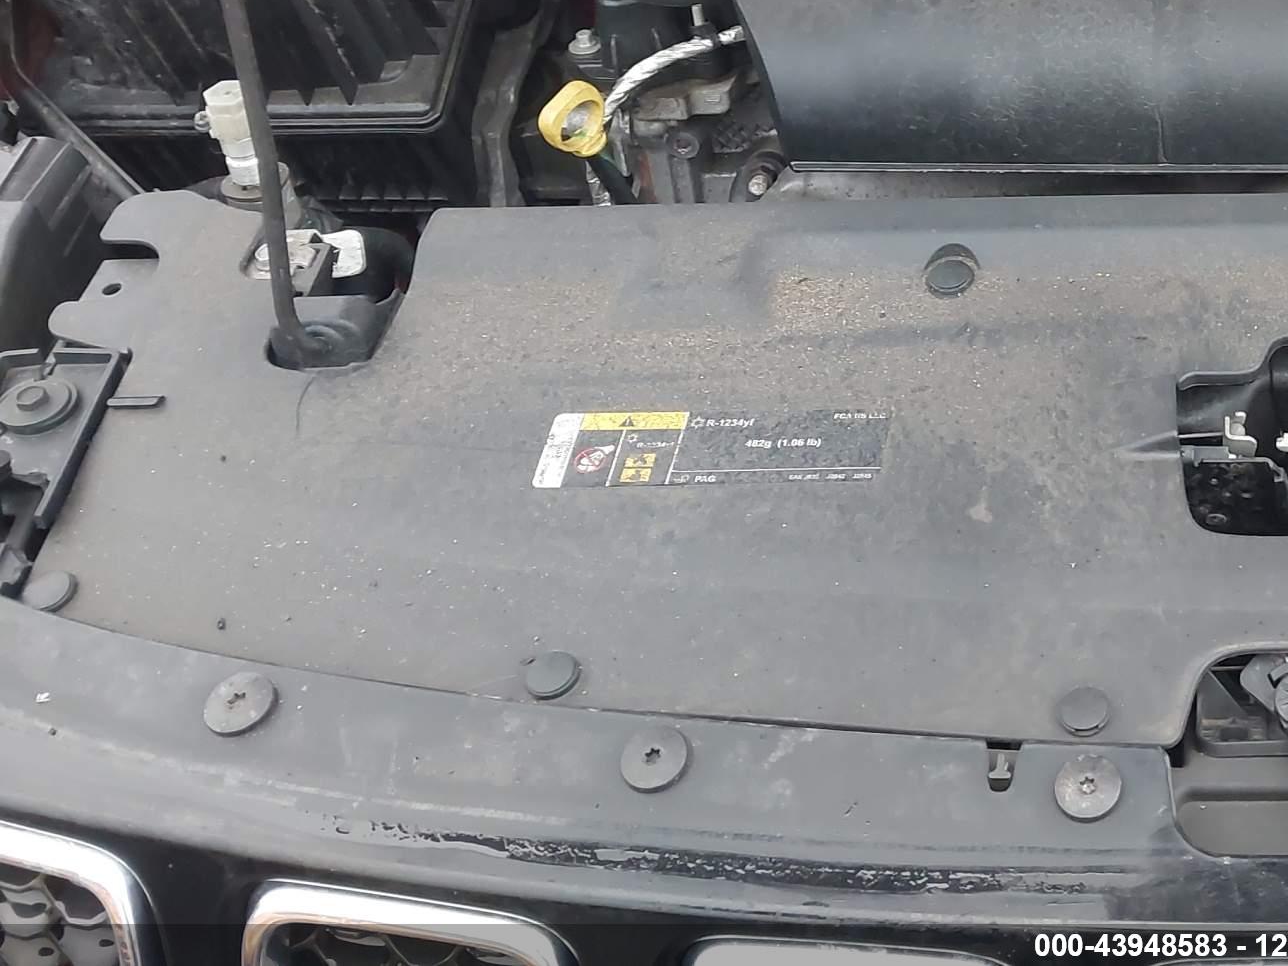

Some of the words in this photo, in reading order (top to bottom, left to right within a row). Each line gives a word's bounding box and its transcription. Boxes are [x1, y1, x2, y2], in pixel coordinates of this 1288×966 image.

[705, 418, 755, 429] R-1234yf
[745, 439, 772, 449] 482g
[777, 438, 804, 449] (1.06
[694, 475, 717, 483] PAG
